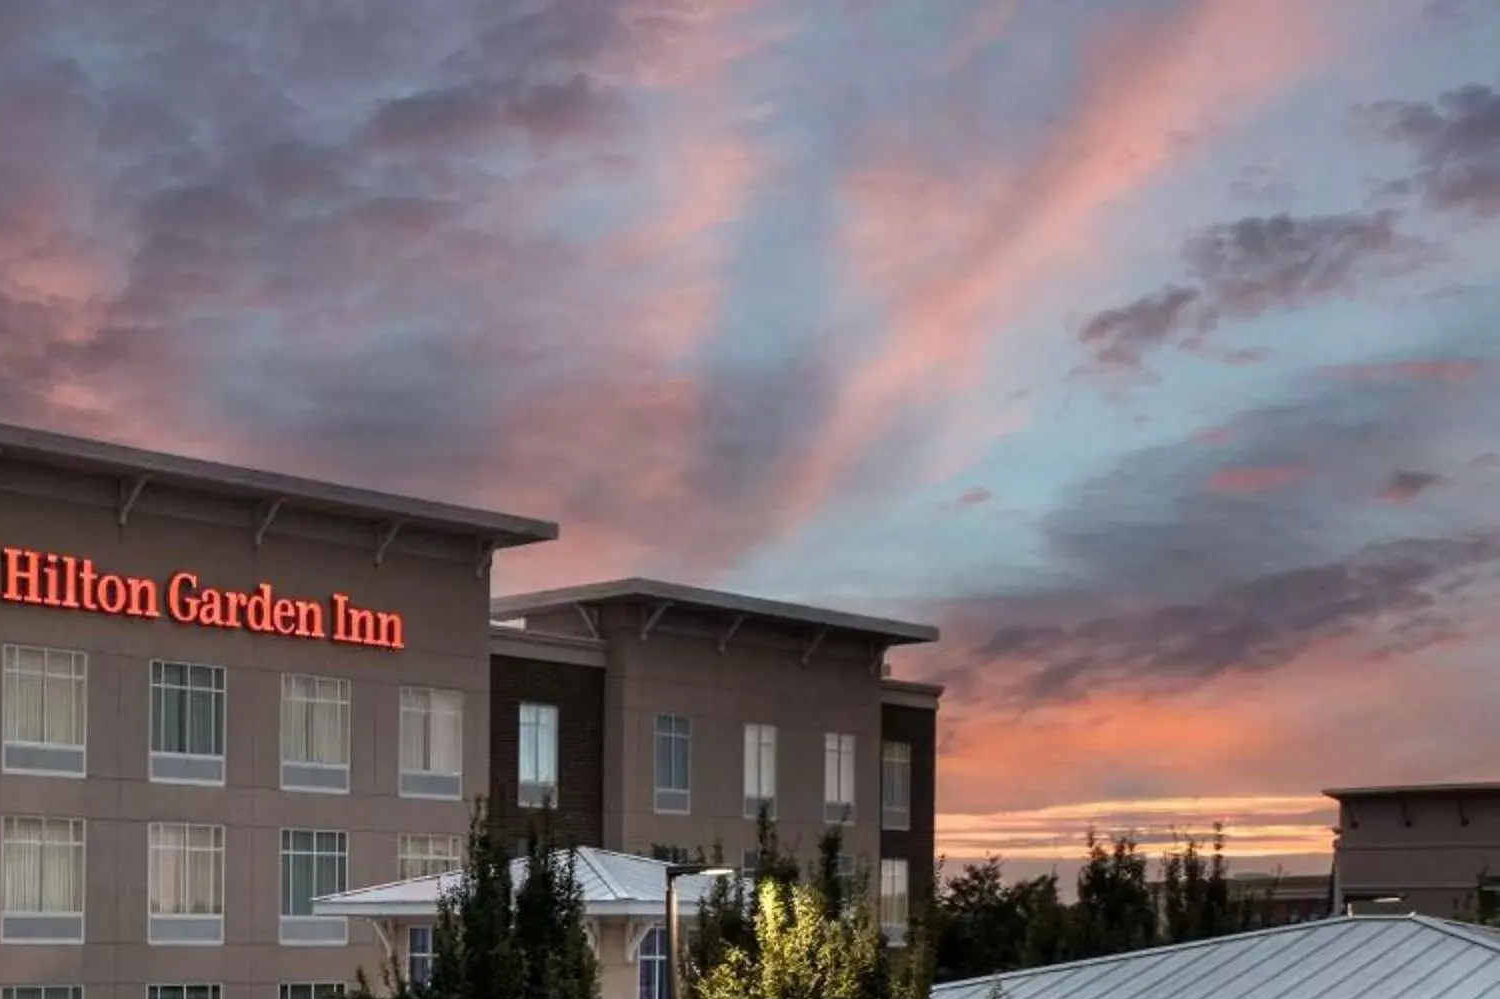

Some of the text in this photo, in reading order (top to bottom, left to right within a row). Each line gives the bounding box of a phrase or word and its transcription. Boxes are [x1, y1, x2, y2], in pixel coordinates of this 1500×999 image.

[3, 548, 404, 648] Hilton Garden Inn
